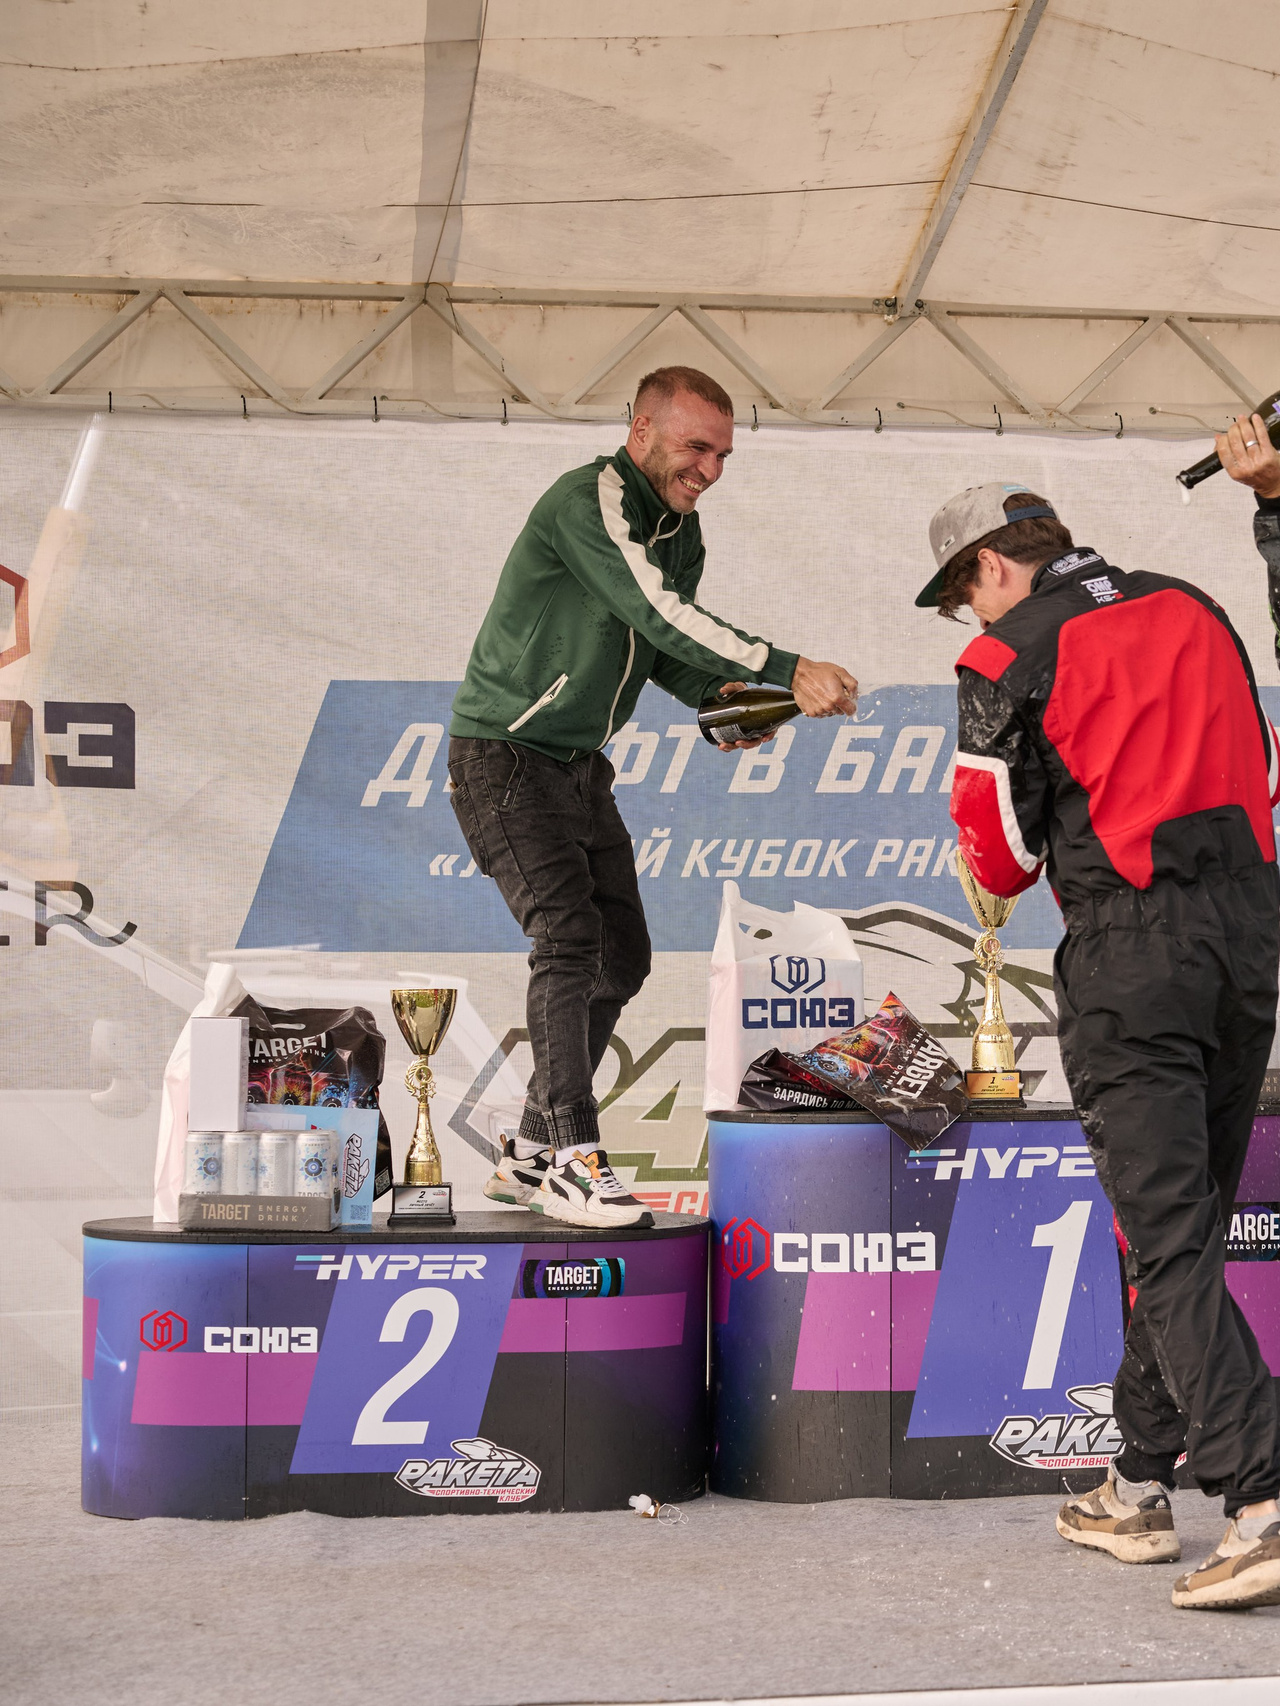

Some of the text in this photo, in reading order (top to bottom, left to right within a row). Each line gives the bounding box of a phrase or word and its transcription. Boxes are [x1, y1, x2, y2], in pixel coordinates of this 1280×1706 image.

[1086, 579, 1113, 593] OMP
[681, 839, 858, 878] КУБОК
[742, 998, 855, 1030] СОЮЗ
[773, 1086, 828, 1108] ЗАРЯДИСЬ
[201, 1203, 307, 1220] TARGET ENERGY
[258, 1214, 298, 1222] DRINK
[773, 1231, 936, 1273] СОЮЗ
[316, 1254, 487, 1280] HYPER
[546, 1266, 599, 1285] TARGET
[1022, 1201, 1093, 1389] 1
[203, 1325, 319, 1354] СОЮЗ
[352, 1287, 459, 1445] 2
[397, 1459, 540, 1488] РАКЕТА
[435, 1487, 536, 1496] СПОРТИВНО-ТЕХНИЧЕСКИЙ
